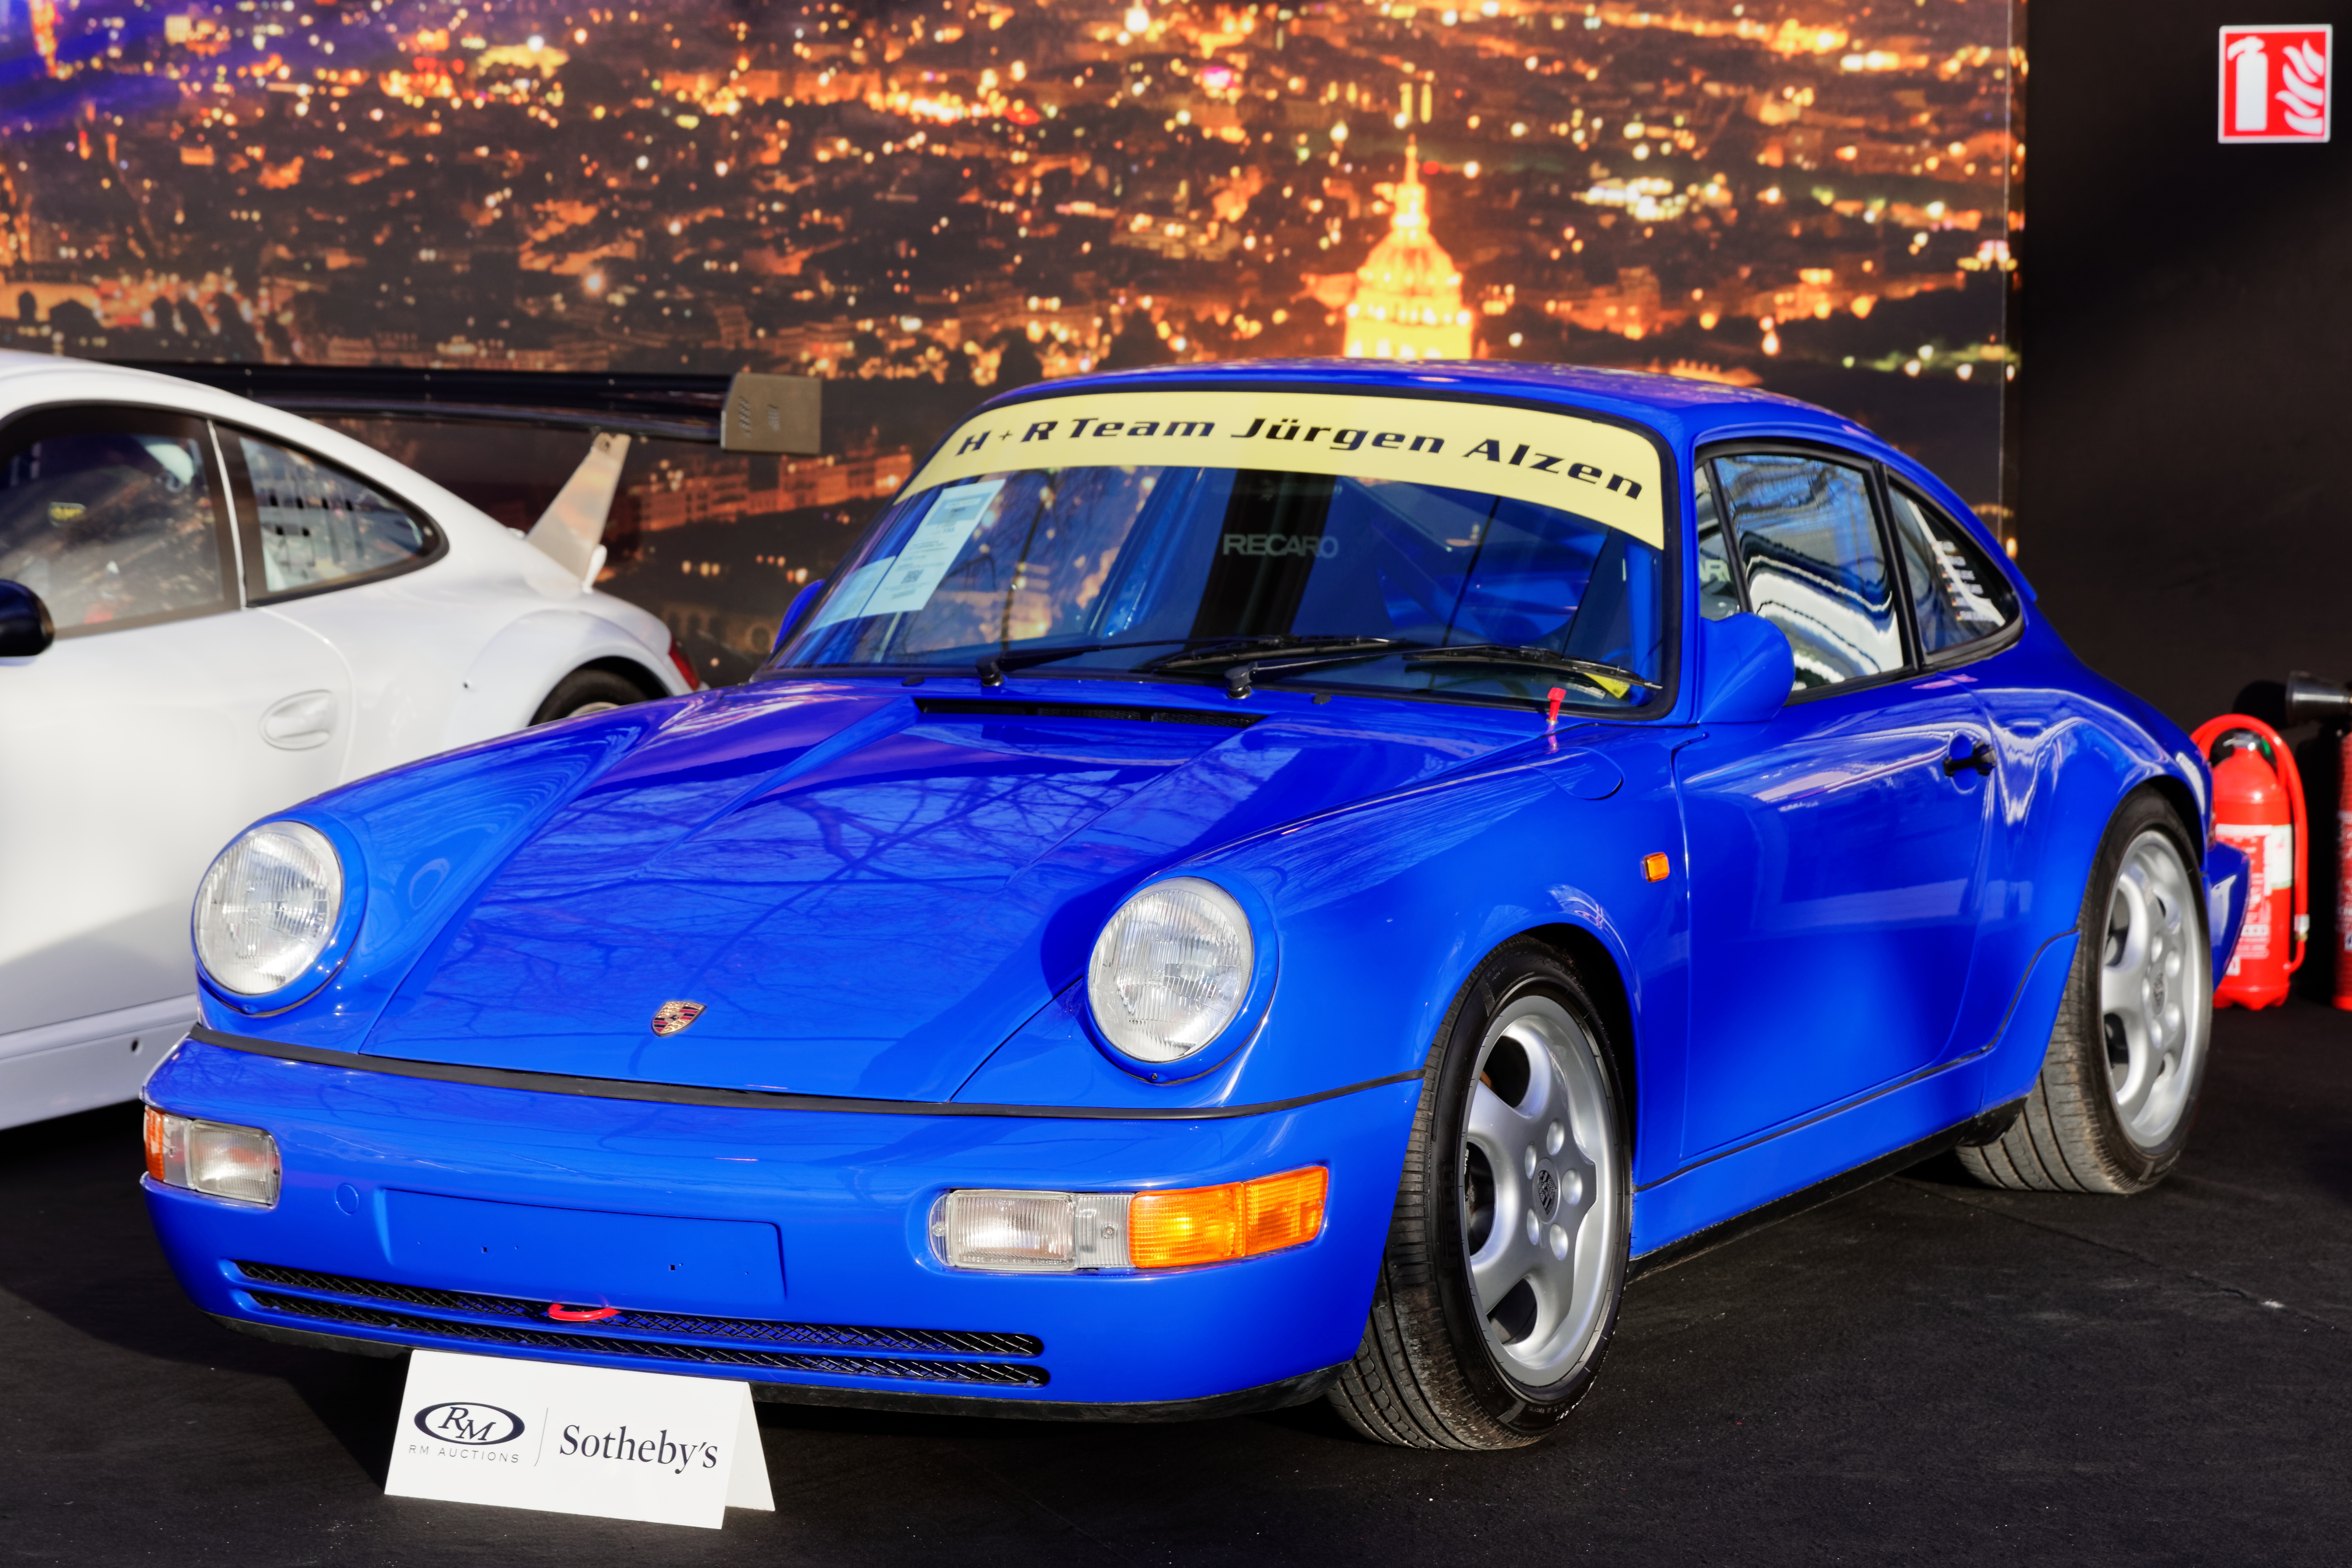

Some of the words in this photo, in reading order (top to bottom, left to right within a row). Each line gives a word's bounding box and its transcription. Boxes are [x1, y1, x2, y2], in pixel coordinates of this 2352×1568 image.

[955, 430, 992, 456] H
[1020, 420, 1059, 443] R
[1069, 418, 1216, 438] Team
[1230, 418, 1445, 454] Jürgen
[1462, 438, 1643, 500] Alzen
[1222, 533, 1339, 559] RECARO
[438, 1406, 496, 1441] RM
[408, 1445, 429, 1455] RM
[438, 1447, 519, 1464] AUCTIONS
[559, 1424, 718, 1475] Sotheby's
